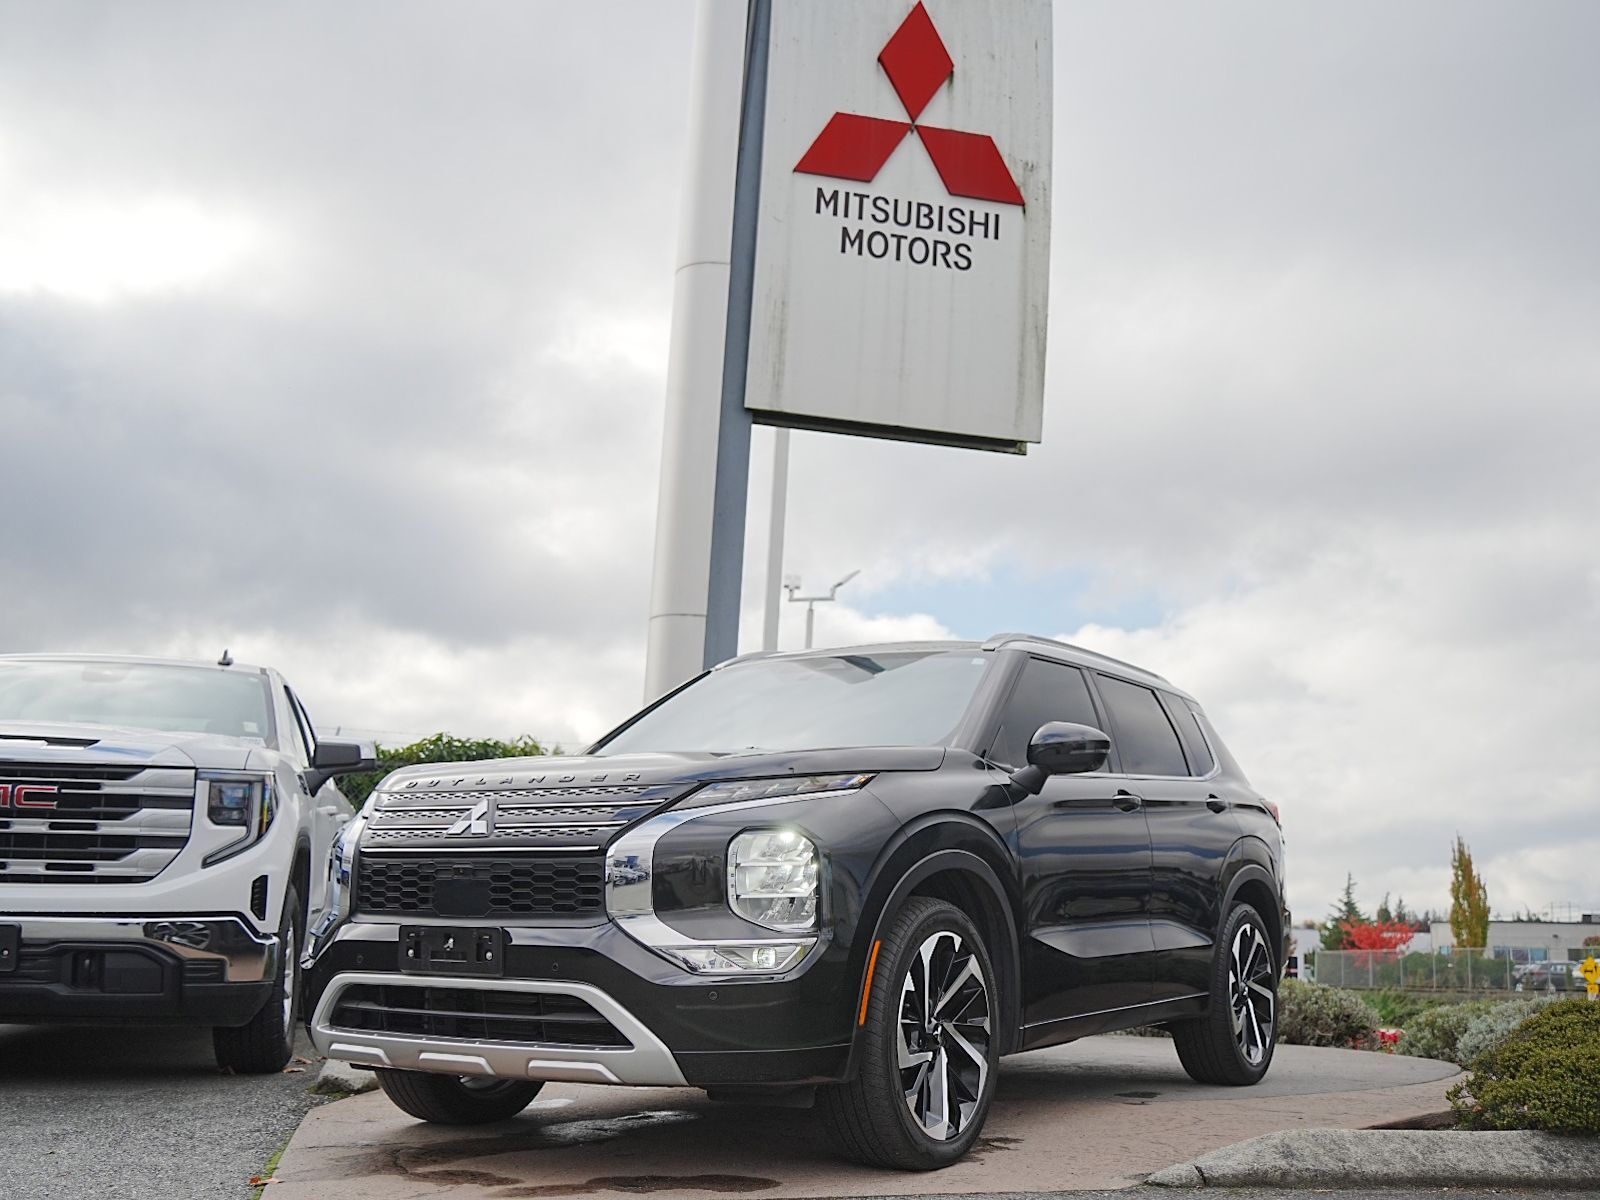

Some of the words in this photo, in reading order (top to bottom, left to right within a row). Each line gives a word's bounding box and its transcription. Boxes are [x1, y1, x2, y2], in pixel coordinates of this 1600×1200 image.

[815, 187, 1000, 240] MITSUBISHI
[840, 226, 972, 271] MOTORS
[0, 784, 58, 809] C
[405, 773, 641, 789] OUTLANDER
